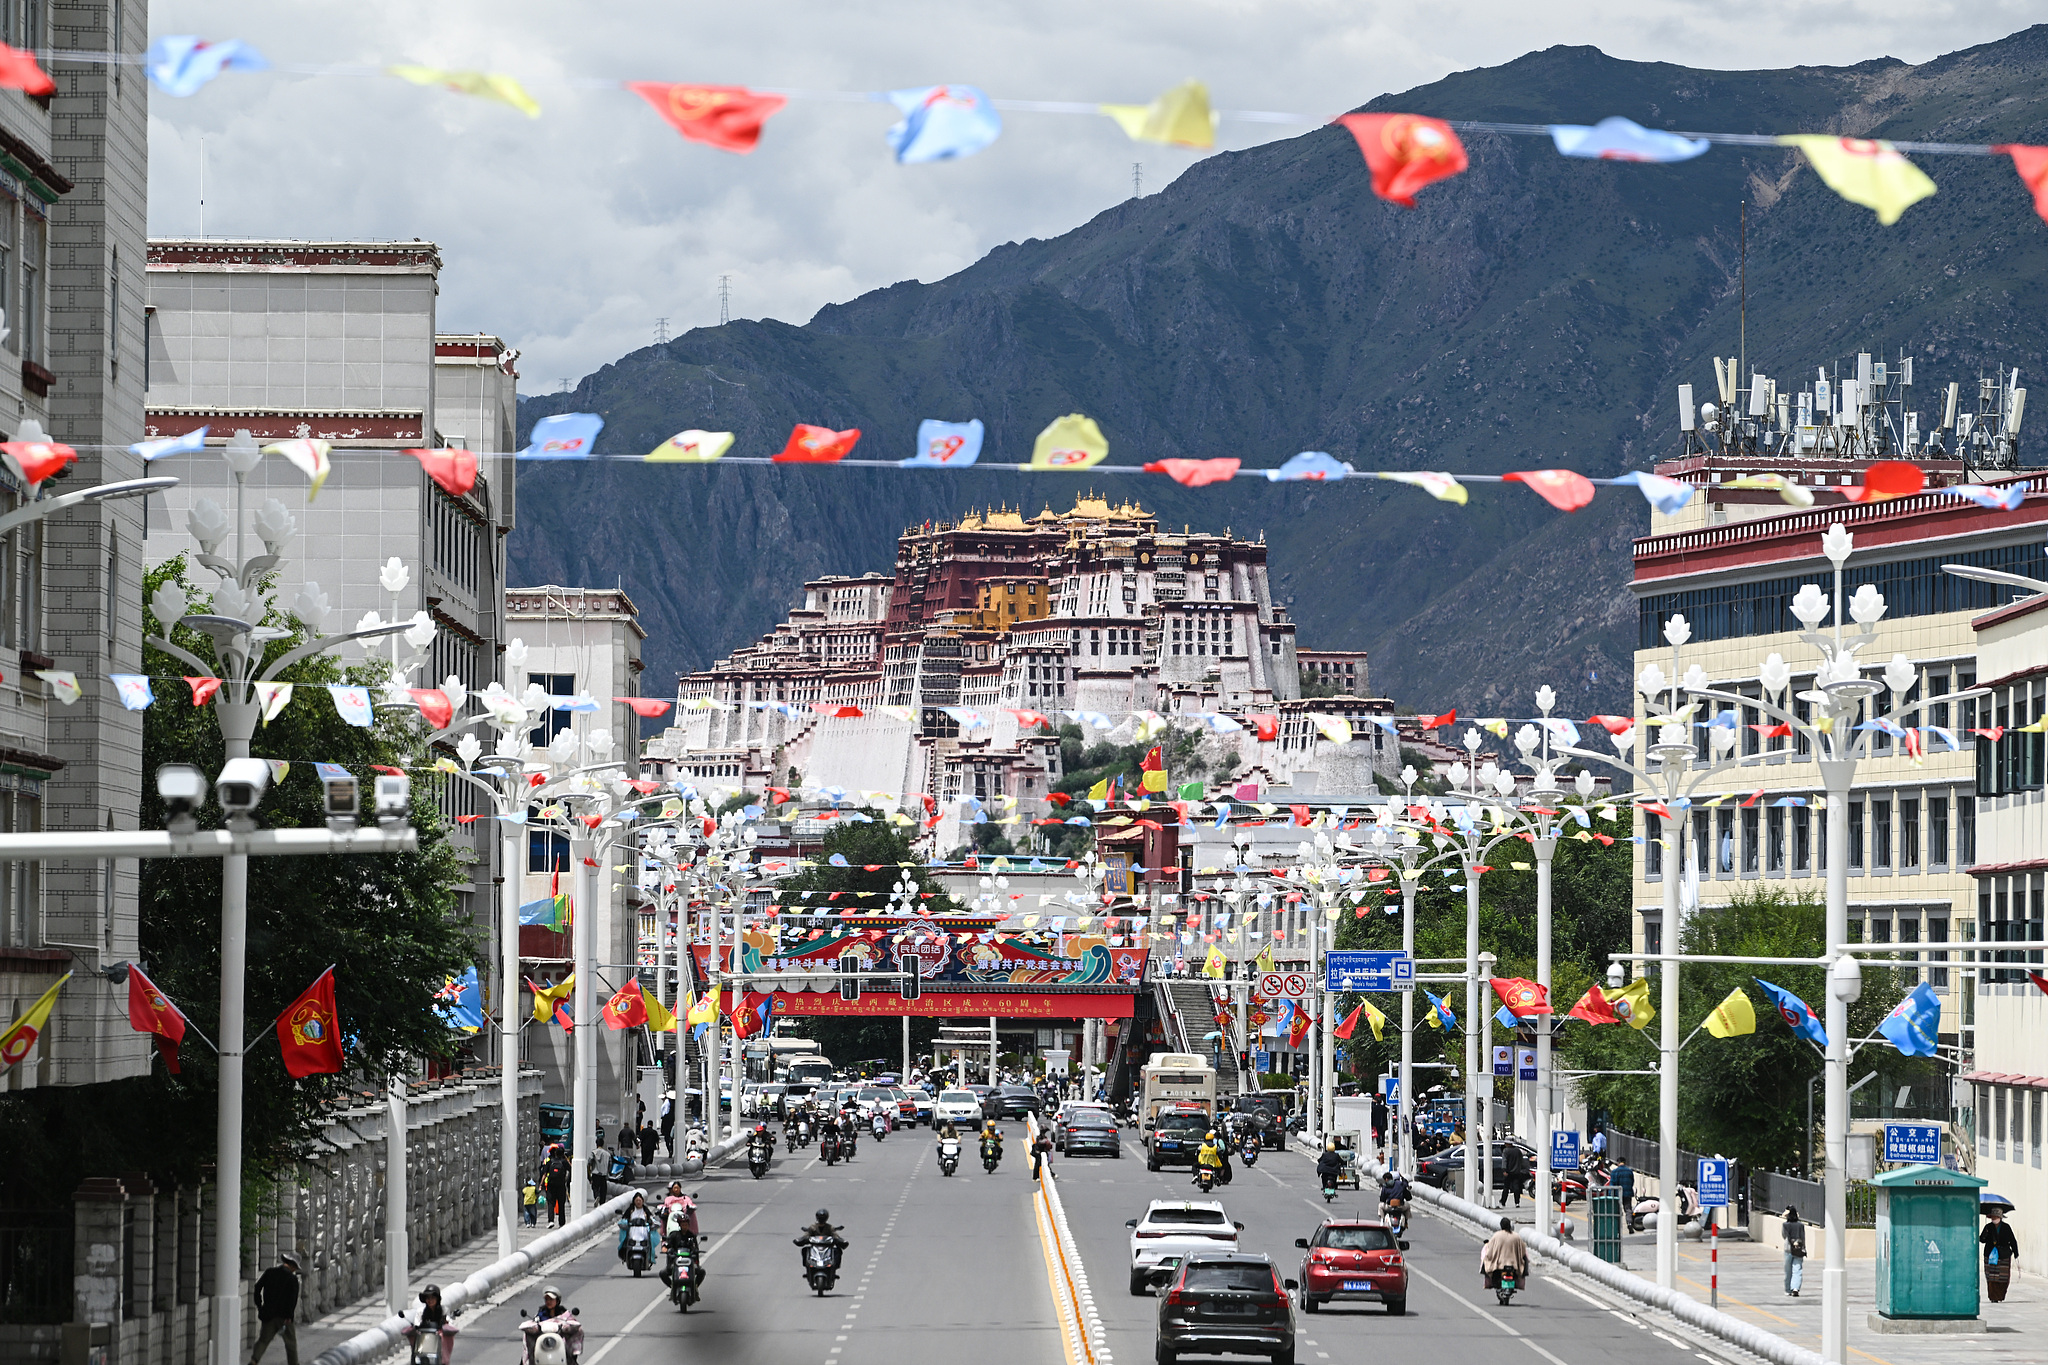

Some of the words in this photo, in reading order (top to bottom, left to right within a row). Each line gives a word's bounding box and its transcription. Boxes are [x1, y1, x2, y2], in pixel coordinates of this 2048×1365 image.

[900, 944, 941, 954] 民族团结
[766, 957, 874, 971] 看着北斗星走路
[977, 958, 1084, 971] 跟着共产党走会幸福
[795, 997, 1052, 1008] 热烈庆祝西藏自治区成立60周年
[1889, 1127, 1936, 1139] 公交车
[1556, 1133, 1569, 1149] P
[1703, 1162, 1716, 1182] P
